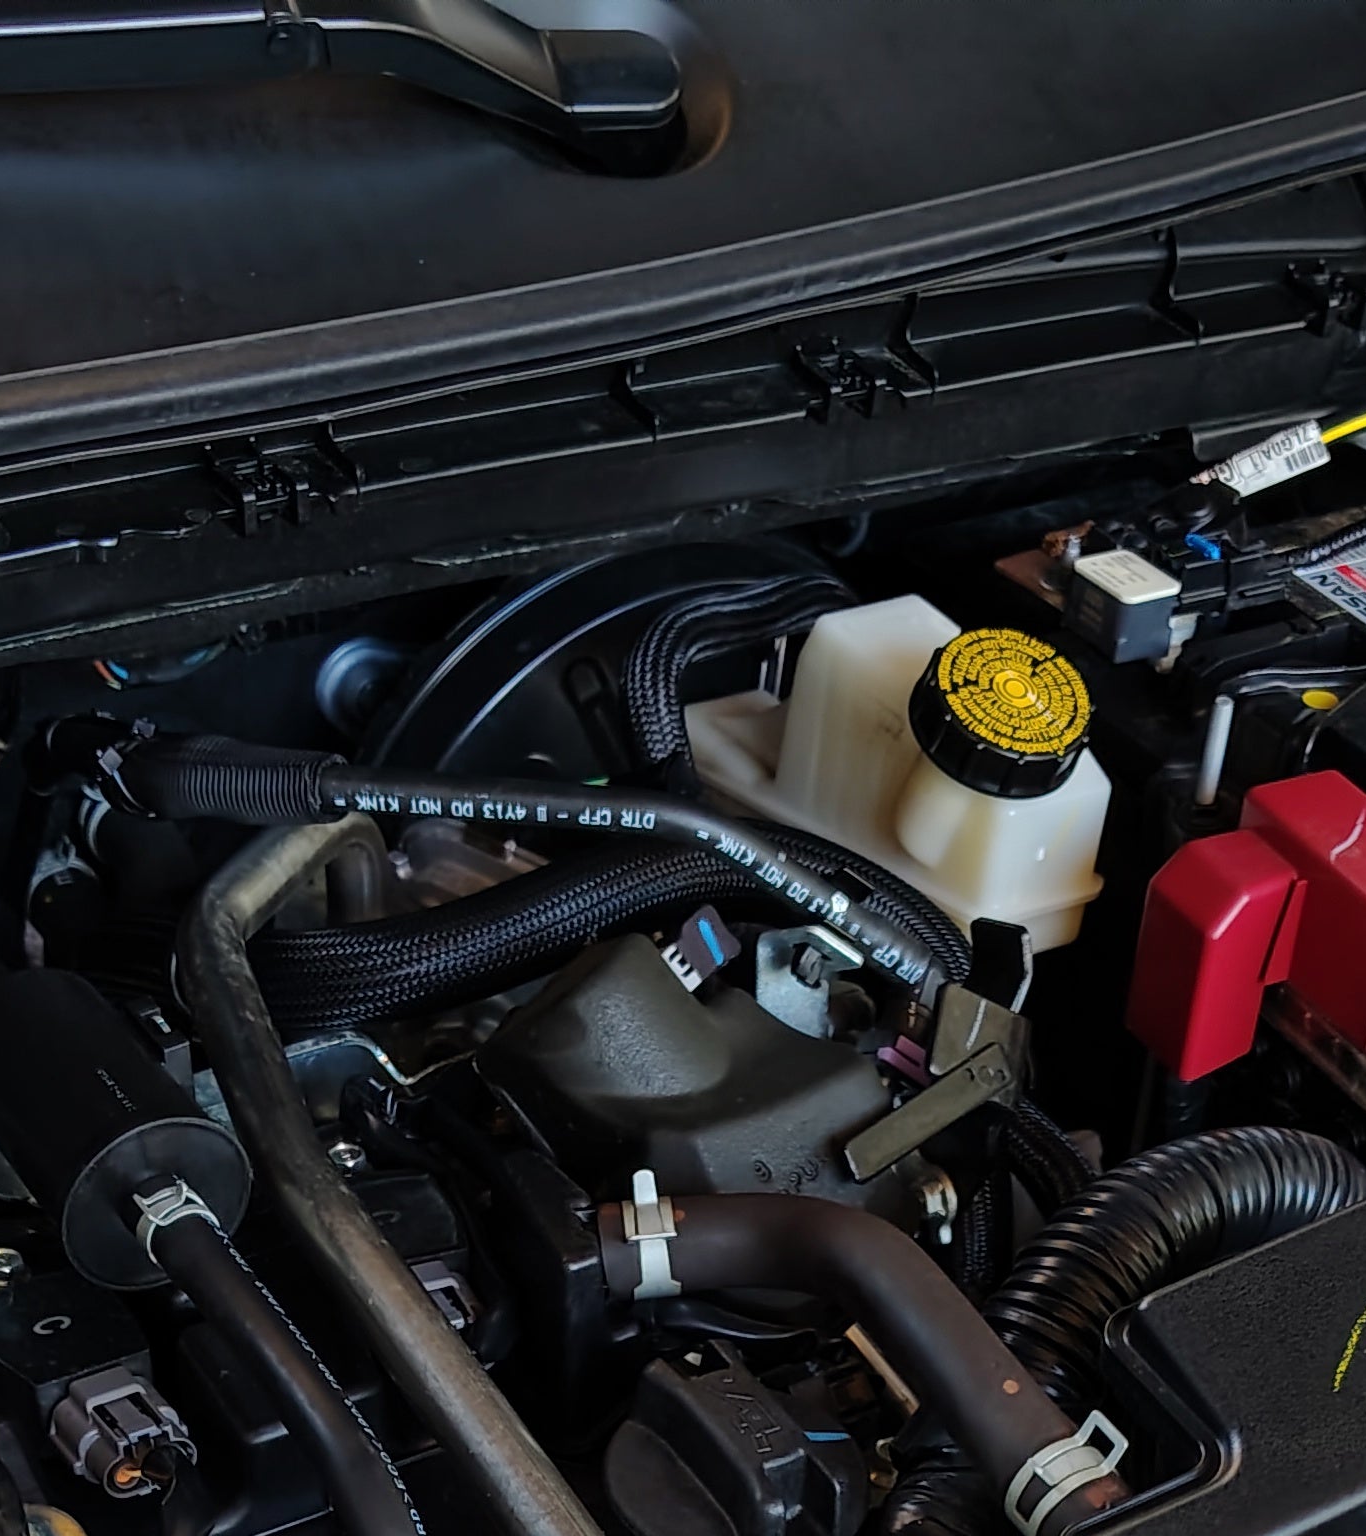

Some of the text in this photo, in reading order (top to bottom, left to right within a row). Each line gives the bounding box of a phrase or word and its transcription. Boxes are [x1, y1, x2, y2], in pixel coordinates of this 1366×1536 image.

[357, 794, 400, 813] KINK
[409, 797, 442, 816] NOT
[451, 801, 474, 818] DO
[483, 804, 526, 822] 4Y13
[579, 808, 612, 827] CFP
[621, 810, 655, 829] DTR
[713, 835, 758, 867] KINK
[756, 860, 786, 889] NOT
[786, 880, 810, 901] DO
[874, 945, 898, 968] CFP
